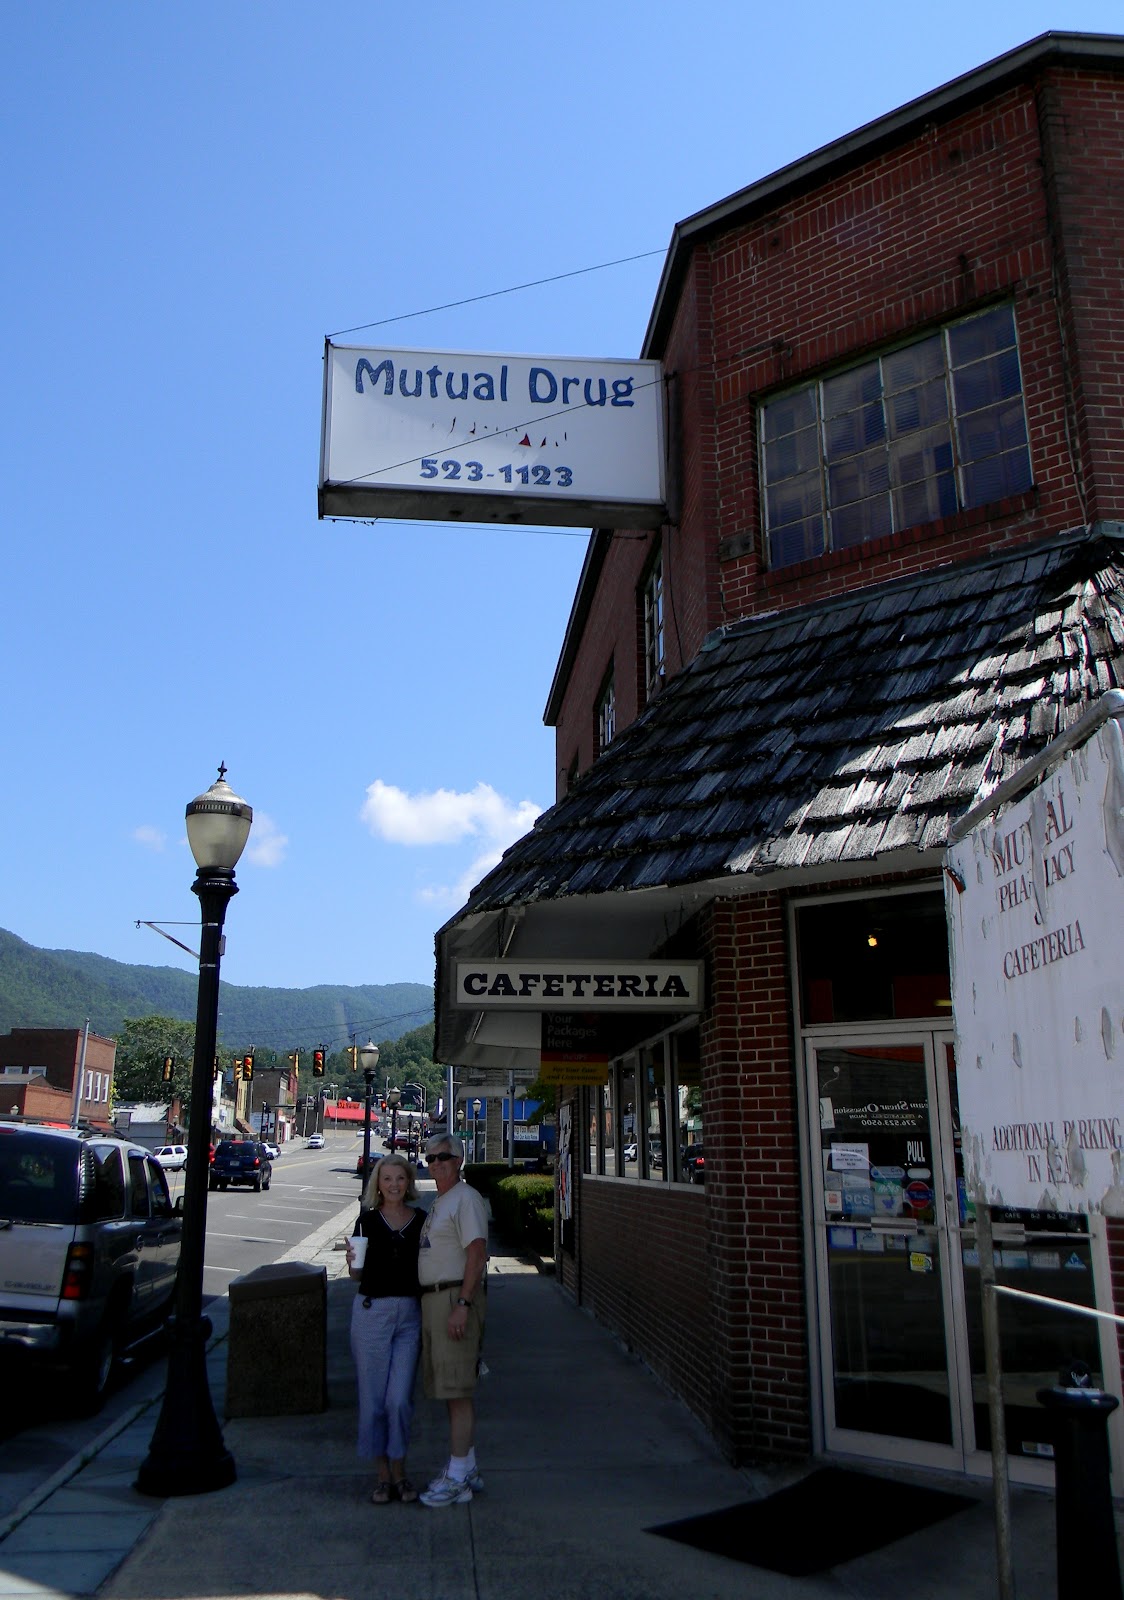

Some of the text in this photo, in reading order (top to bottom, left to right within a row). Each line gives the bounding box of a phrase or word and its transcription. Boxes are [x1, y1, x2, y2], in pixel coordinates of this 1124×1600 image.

[356, 358, 634, 407] Mutual Drug
[420, 459, 573, 487] 523-1123
[990, 792, 1074, 877] MUAL
[998, 840, 1075, 914] PHAACY
[1003, 919, 1085, 980] CAFETERIA
[463, 973, 690, 998] CAFETERIA
[547, 1025, 598, 1039] Packages
[547, 1037, 573, 1049] Here
[1063, 1118, 1123, 1150] PRKING
[907, 1140, 926, 1163] PULL
[1027, 1155, 1041, 1182] IN
